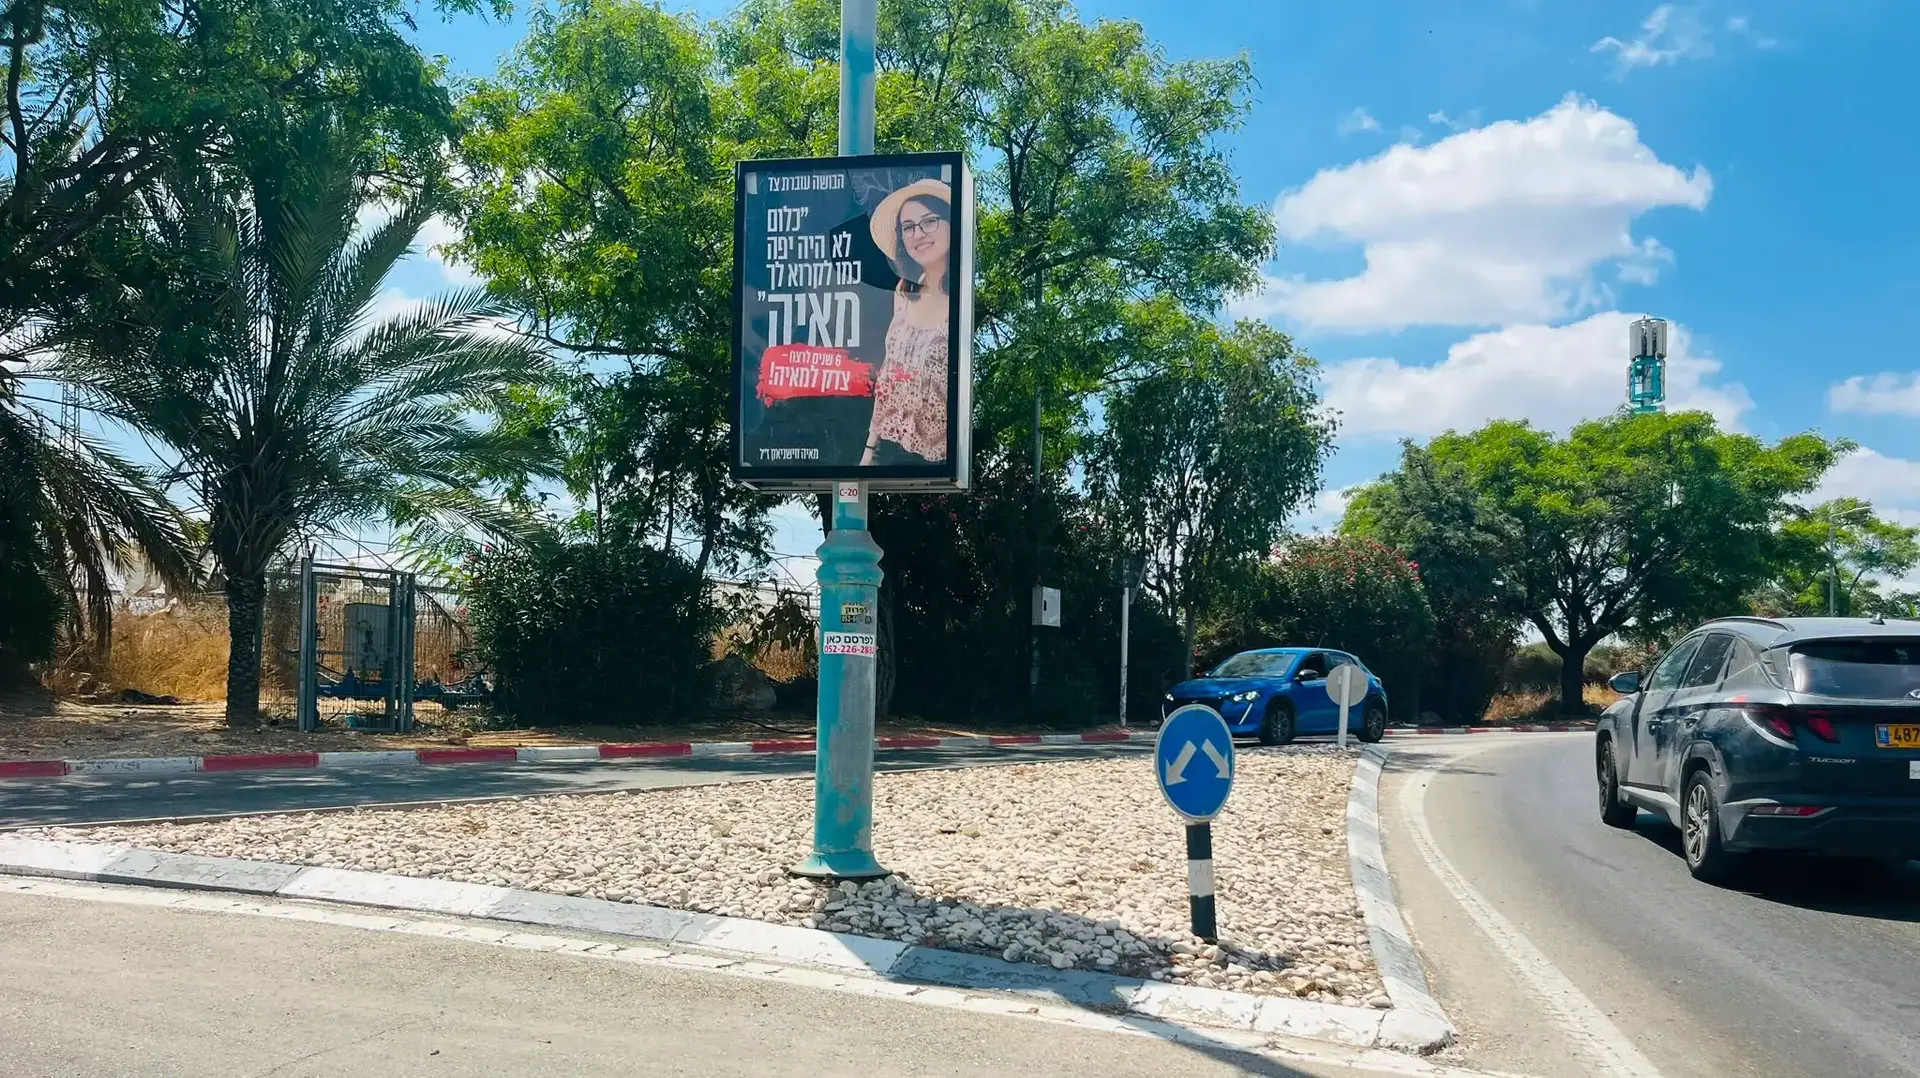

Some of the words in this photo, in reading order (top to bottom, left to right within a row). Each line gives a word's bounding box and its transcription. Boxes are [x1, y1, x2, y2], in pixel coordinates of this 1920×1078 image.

[767, 176, 780, 192] צד
[781, 175, 811, 191] עוברת
[812, 174, 845, 190] הבושה
[767, 235, 794, 260] יפה
[798, 235, 825, 259] היה
[832, 231, 852, 259] לא
[766, 261, 784, 291] לך
[788, 259, 833, 288] לקרוא
[836, 260, 861, 286] כמו
[789, 350, 811, 364] לרצח
[812, 352, 833, 366] שנים
[835, 354, 842, 367] 6
[768, 361, 819, 388] למאיה!
[821, 369, 851, 393] צדק
[801, 448, 819, 460] מאיה
[839, 488, 858, 497] C-20
[826, 635, 841, 645] כאן
[844, 635, 874, 645] לפרסם
